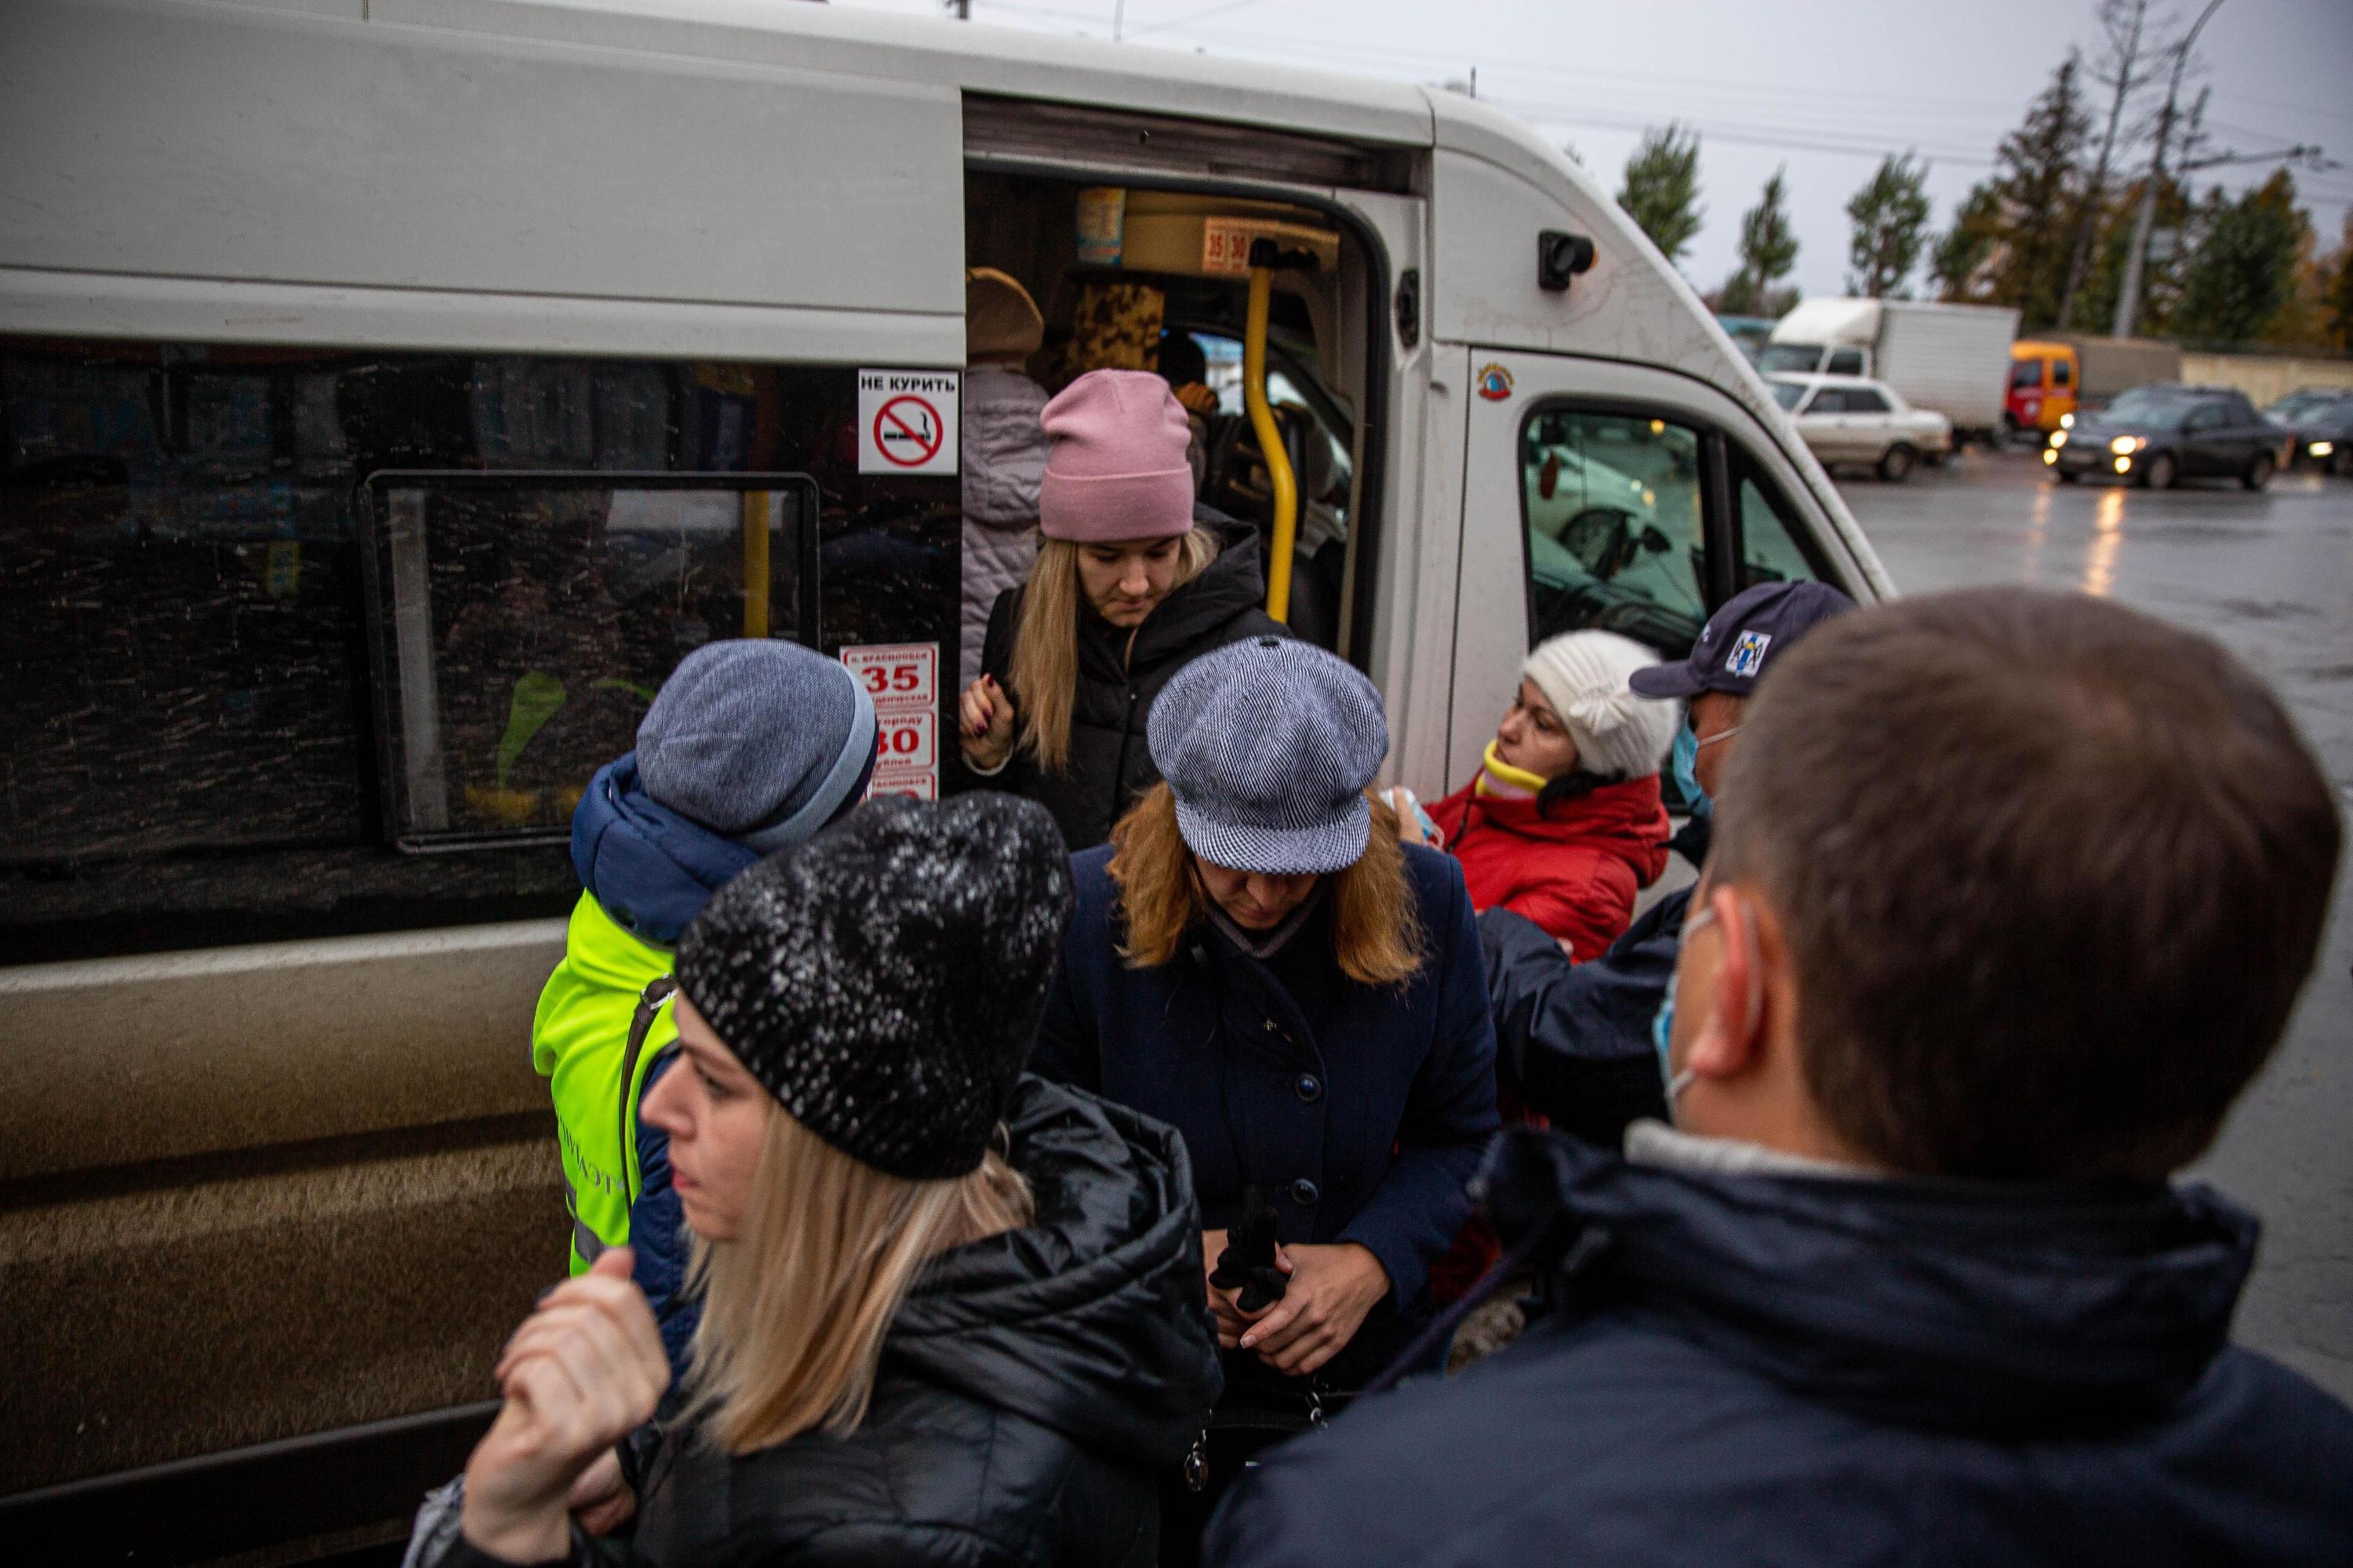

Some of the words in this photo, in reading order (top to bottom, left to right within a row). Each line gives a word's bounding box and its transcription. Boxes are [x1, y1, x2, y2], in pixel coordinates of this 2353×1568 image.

[861, 377, 883, 390] НЕ
[889, 377, 955, 391] КУРИТЬ
[862, 664, 919, 693] 35
[876, 758, 911, 772] ублей
